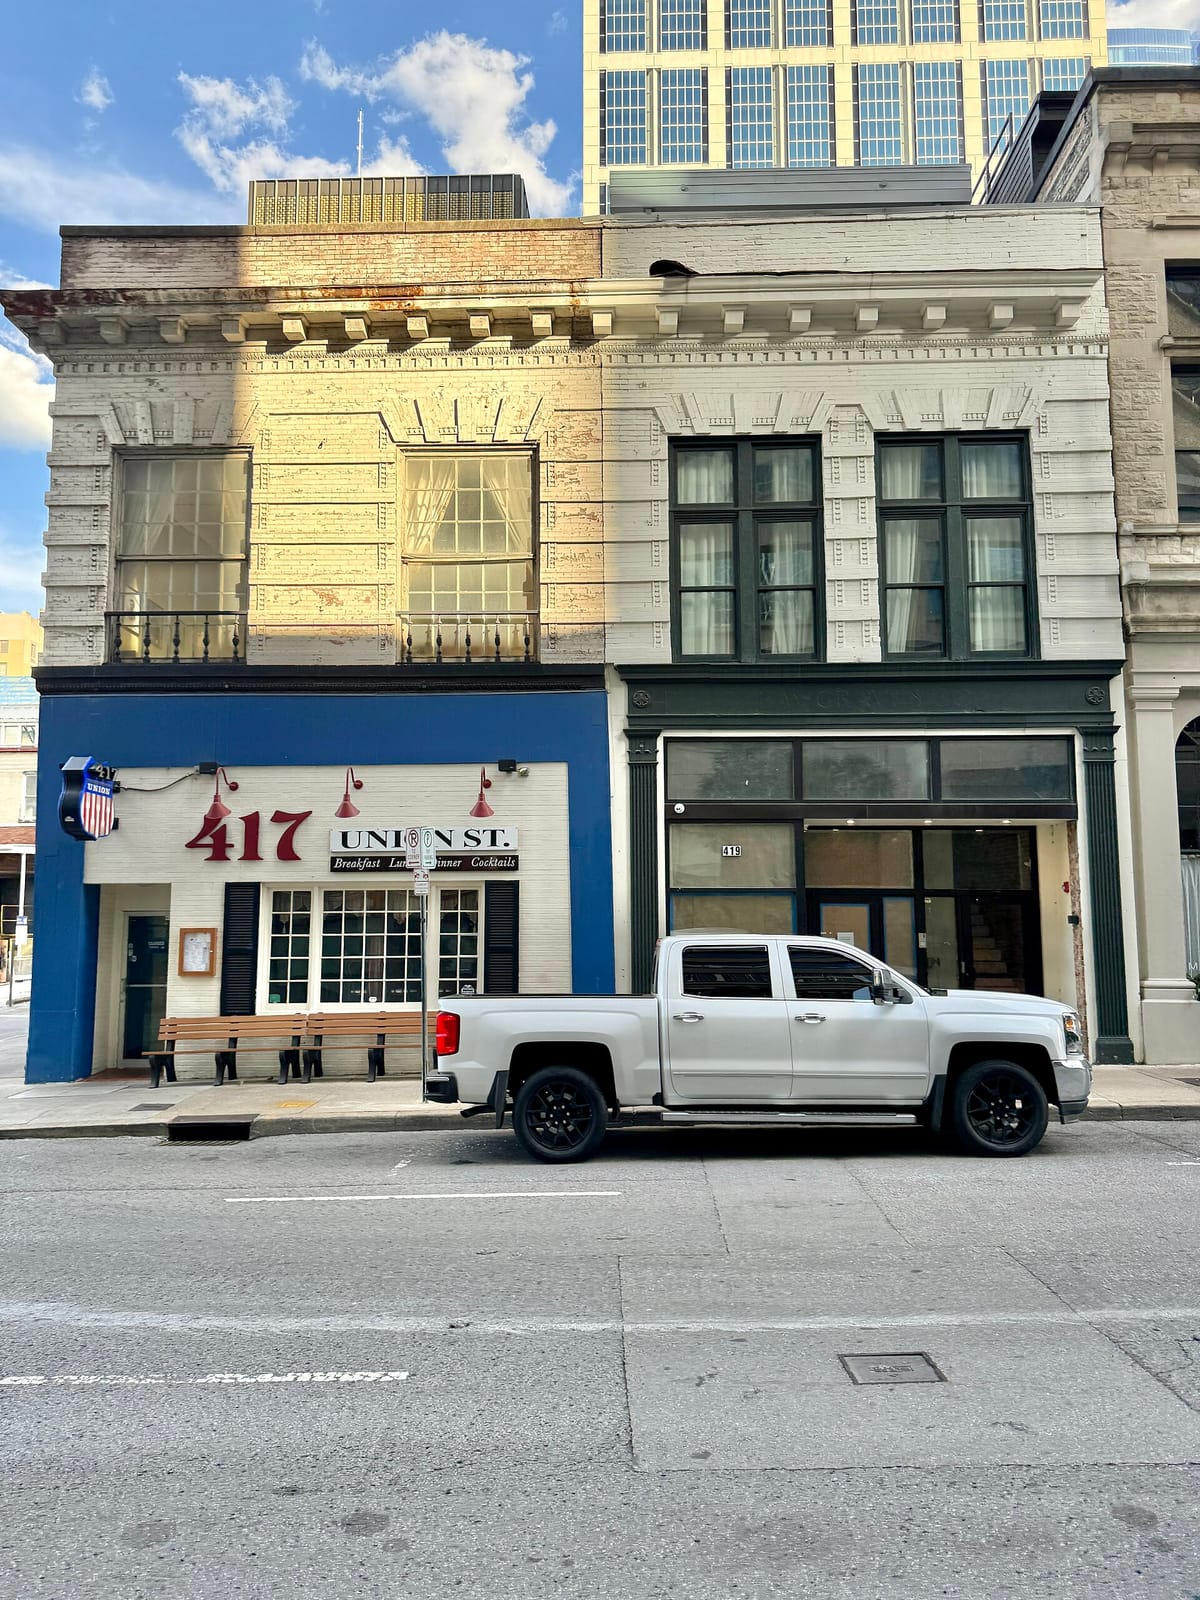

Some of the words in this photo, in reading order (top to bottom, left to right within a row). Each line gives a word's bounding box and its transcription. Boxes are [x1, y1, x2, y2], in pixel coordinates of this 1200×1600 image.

[95, 764, 119, 781] 417
[87, 782, 111, 796] UNION
[184, 809, 313, 861] 417
[339, 829, 455, 849] UNIN
[463, 828, 511, 848] ST.
[723, 846, 741, 856] 419
[333, 856, 381, 870] Breakfast
[436, 857, 463, 868] inner
[470, 855, 516, 868] Cocktails
